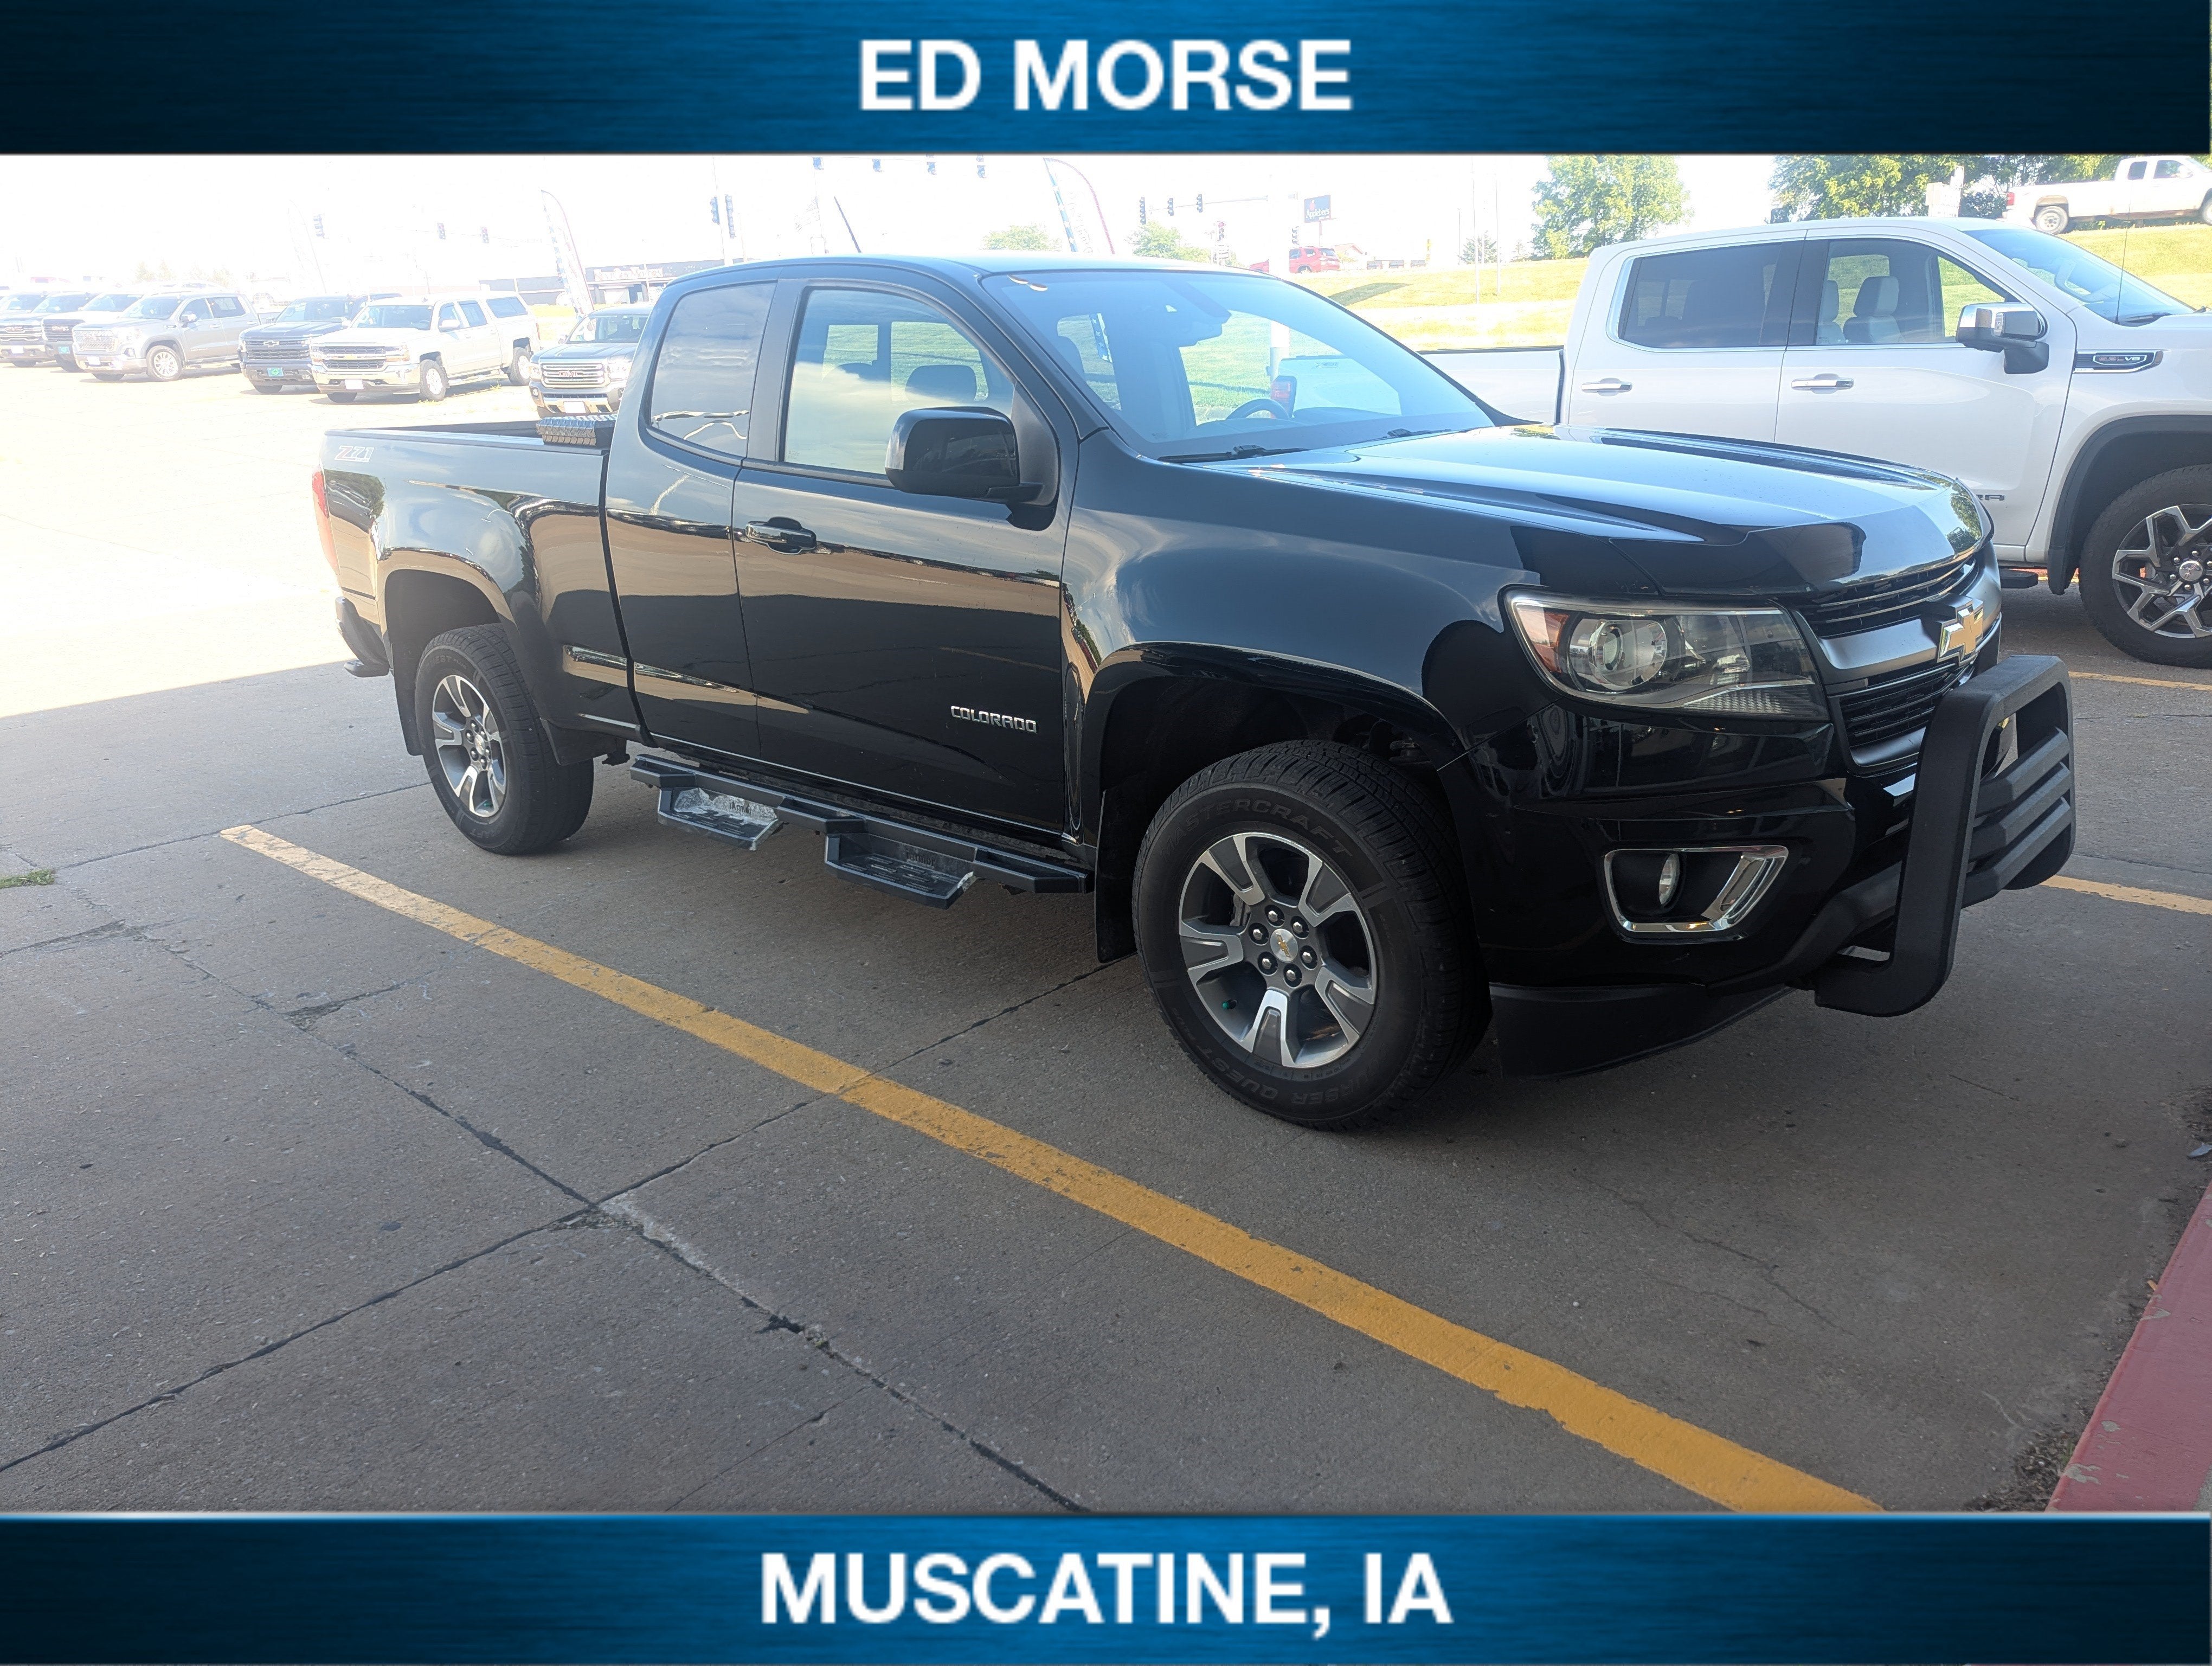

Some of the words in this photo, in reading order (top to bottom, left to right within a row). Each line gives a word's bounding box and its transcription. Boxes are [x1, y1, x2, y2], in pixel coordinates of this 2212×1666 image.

[335, 445, 375, 463] Z71
[950, 705, 1038, 734] COLORADO
[1160, 798, 1353, 864] MASTERCRAFT
